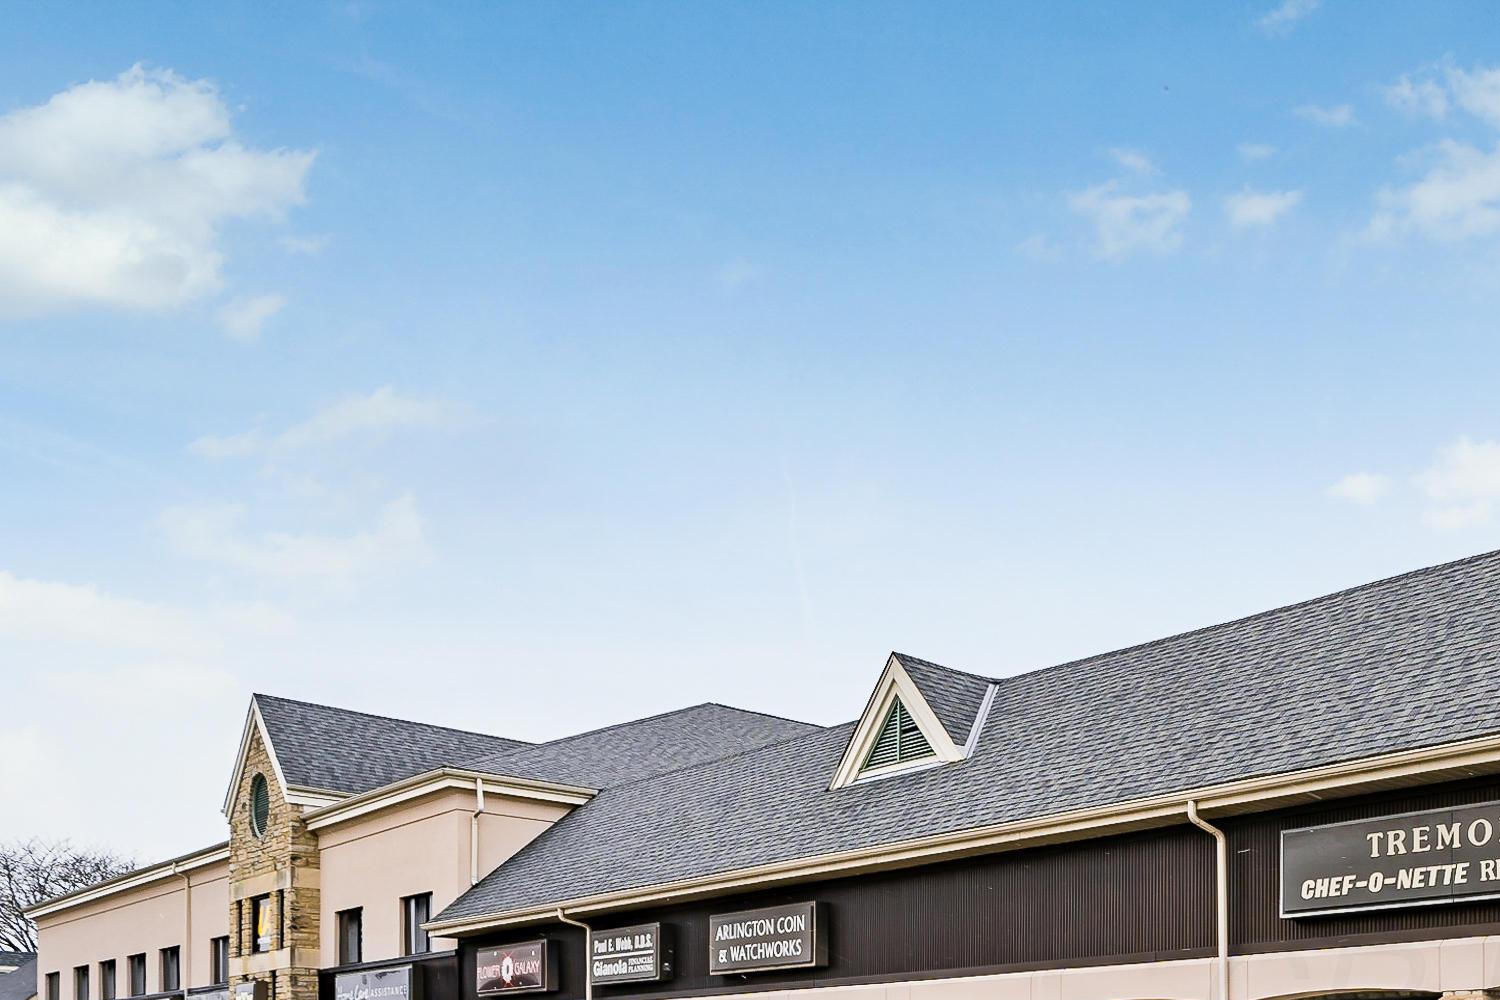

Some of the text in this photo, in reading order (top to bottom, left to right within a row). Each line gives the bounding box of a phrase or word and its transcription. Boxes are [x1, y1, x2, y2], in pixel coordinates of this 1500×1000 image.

[1301, 862, 1470, 900] CHEF-O-NETTE
[715, 914, 806, 941] ARLINGTON COIN
[593, 939, 608, 954] Paul
[718, 939, 802, 963] & WATCHWORKS
[513, 959, 541, 975] GALAXY
[593, 959, 628, 977] Gianola
[370, 984, 408, 998] ASSISTANCE
